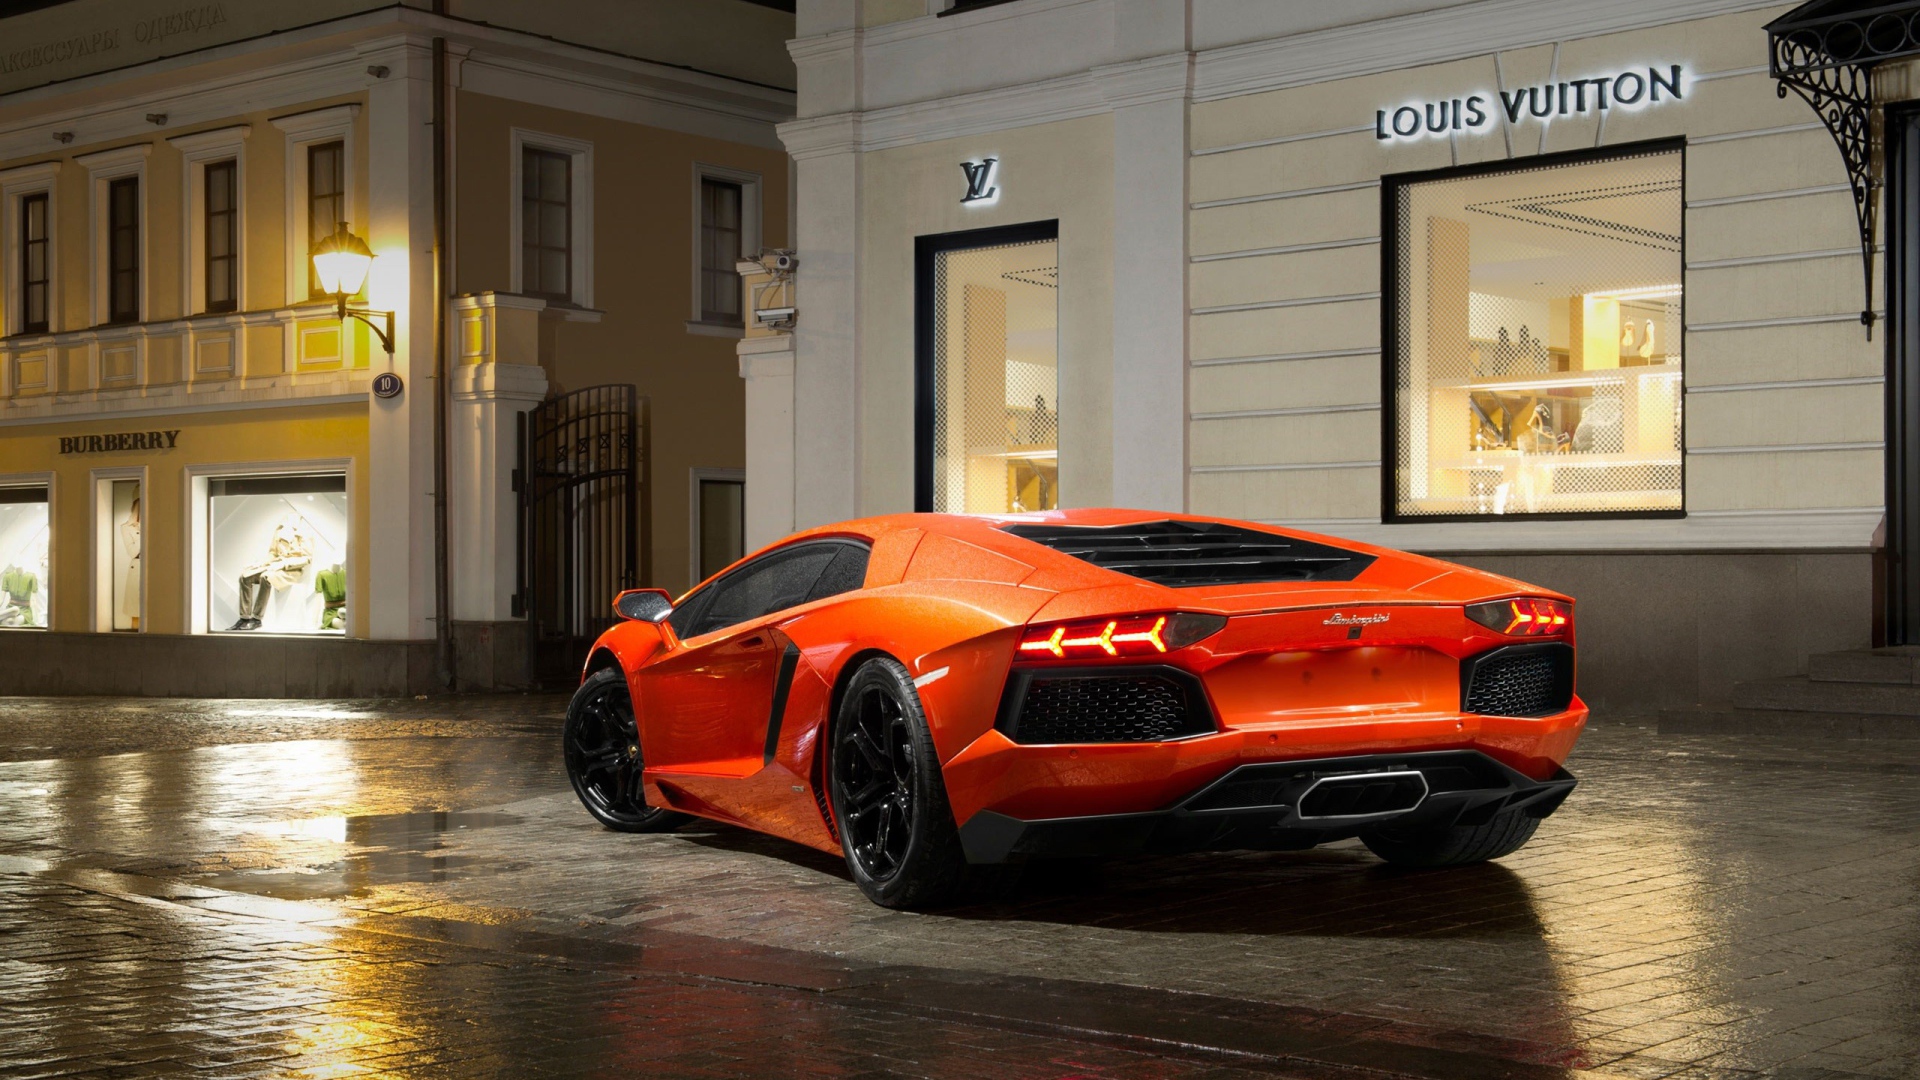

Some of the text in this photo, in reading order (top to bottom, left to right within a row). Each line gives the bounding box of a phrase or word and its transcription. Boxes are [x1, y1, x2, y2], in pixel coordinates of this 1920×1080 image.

[134, 3, 227, 44] ОДЕЖДА
[1376, 64, 1682, 140] LOUIS VUITTON
[381, 377, 392, 391] 10
[58, 430, 181, 454] BURBERRY
[1323, 612, 1391, 627] Lamborghini
